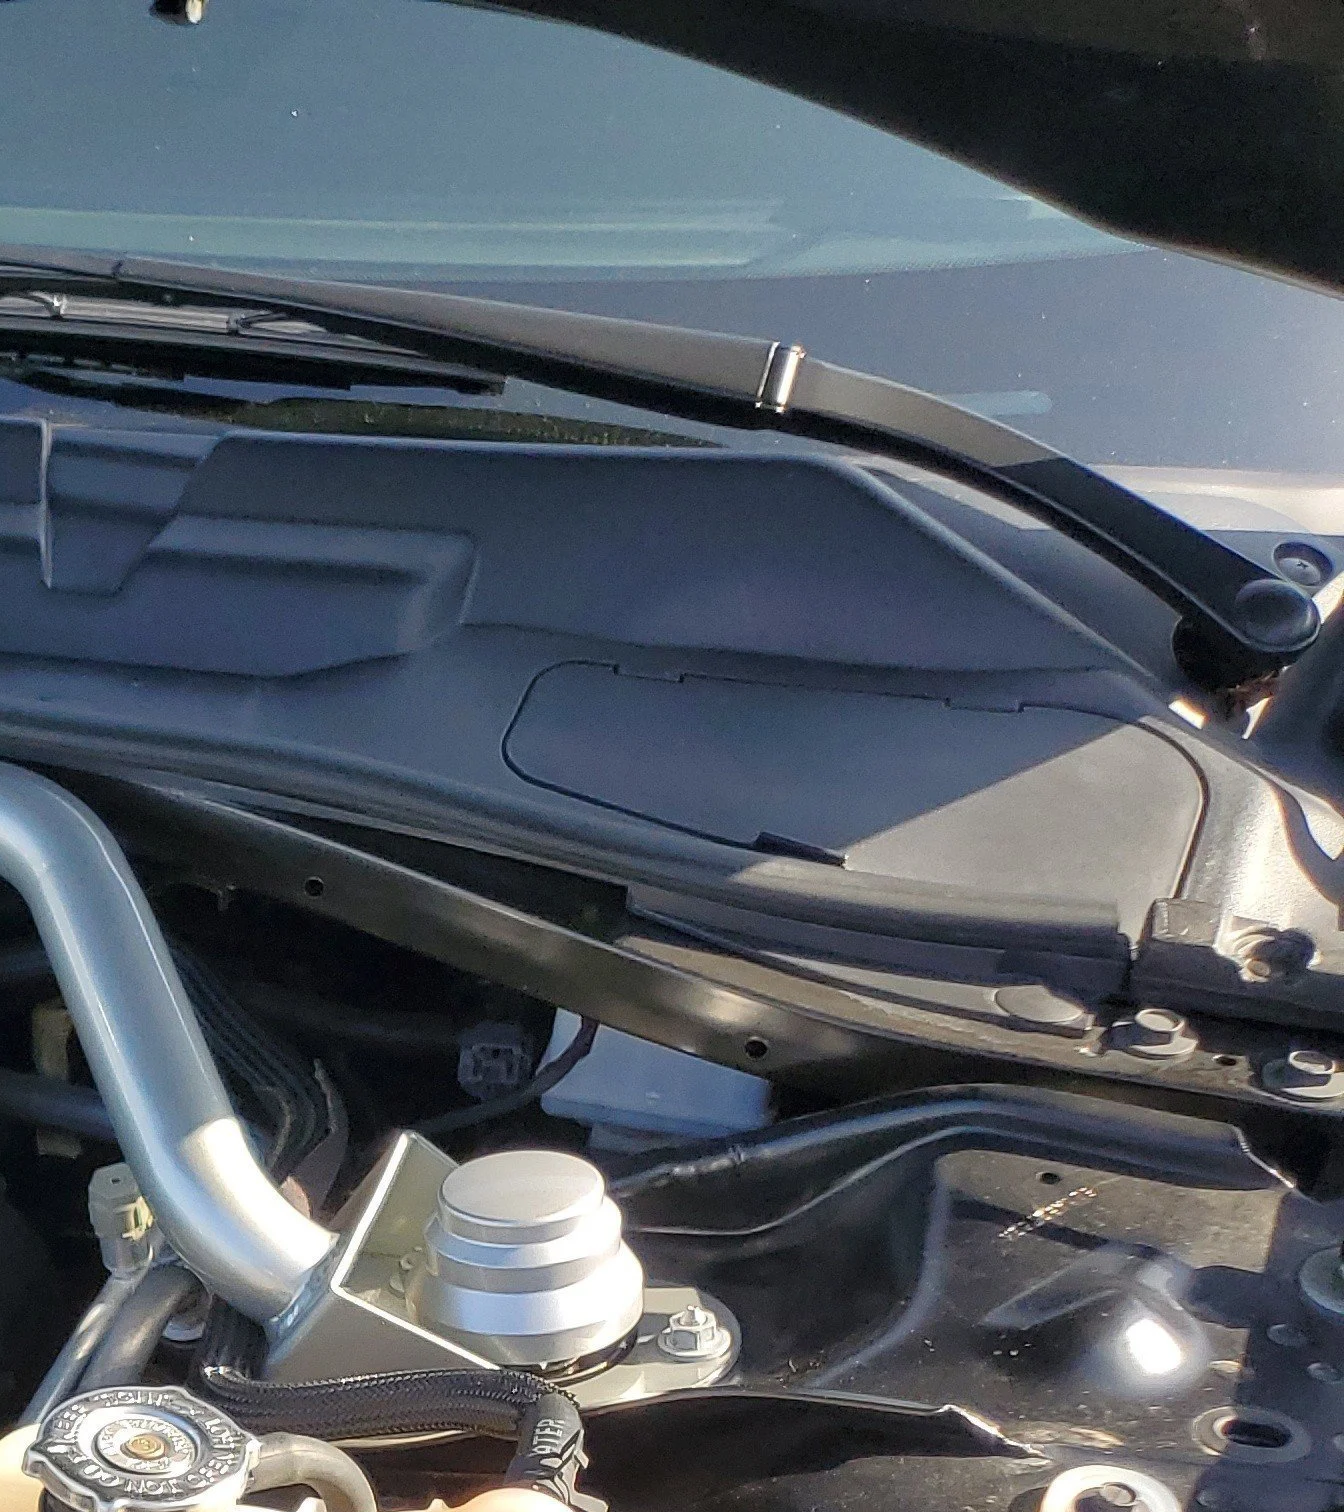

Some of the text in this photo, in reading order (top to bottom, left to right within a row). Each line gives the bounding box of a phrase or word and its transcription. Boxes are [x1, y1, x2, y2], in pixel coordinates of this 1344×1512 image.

[204, 1417, 237, 1449] HOT
[532, 1418, 566, 1456] ATER
[82, 1463, 121, 1488] DO
[124, 1477, 179, 1495] NOT
[187, 1451, 237, 1489] OPEN
